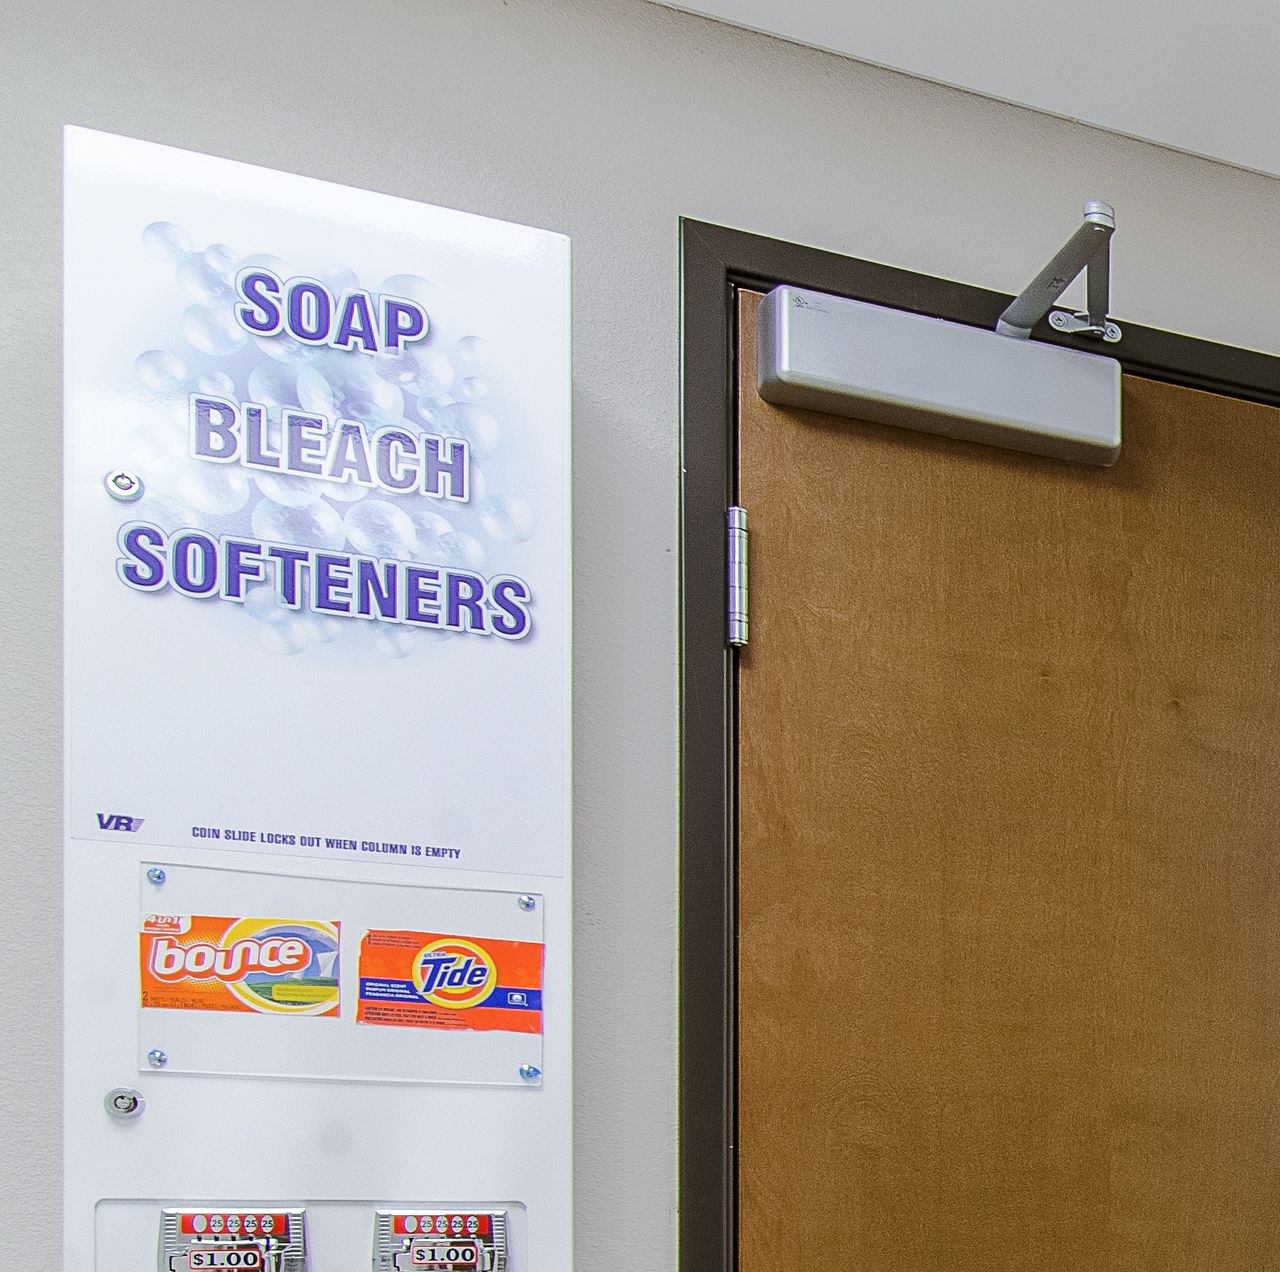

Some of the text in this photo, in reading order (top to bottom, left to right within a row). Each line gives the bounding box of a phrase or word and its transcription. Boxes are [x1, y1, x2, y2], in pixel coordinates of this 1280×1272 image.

[239, 269, 427, 354] SOAP
[194, 396, 470, 500] BLEACH
[121, 524, 531, 637] SOFTENERS
[192, 826, 461, 859] COIN SLIDE LOCKS OUT WHEN COLUMN IS EMPTY
[153, 937, 307, 976] bounce
[420, 956, 489, 993] Tide
[211, 1219, 273, 1228] 25 25 25 25
[421, 1220, 478, 1228] 25 25 25 25
[193, 1252, 258, 1266] $1.00
[415, 1248, 475, 1261] $1.00
